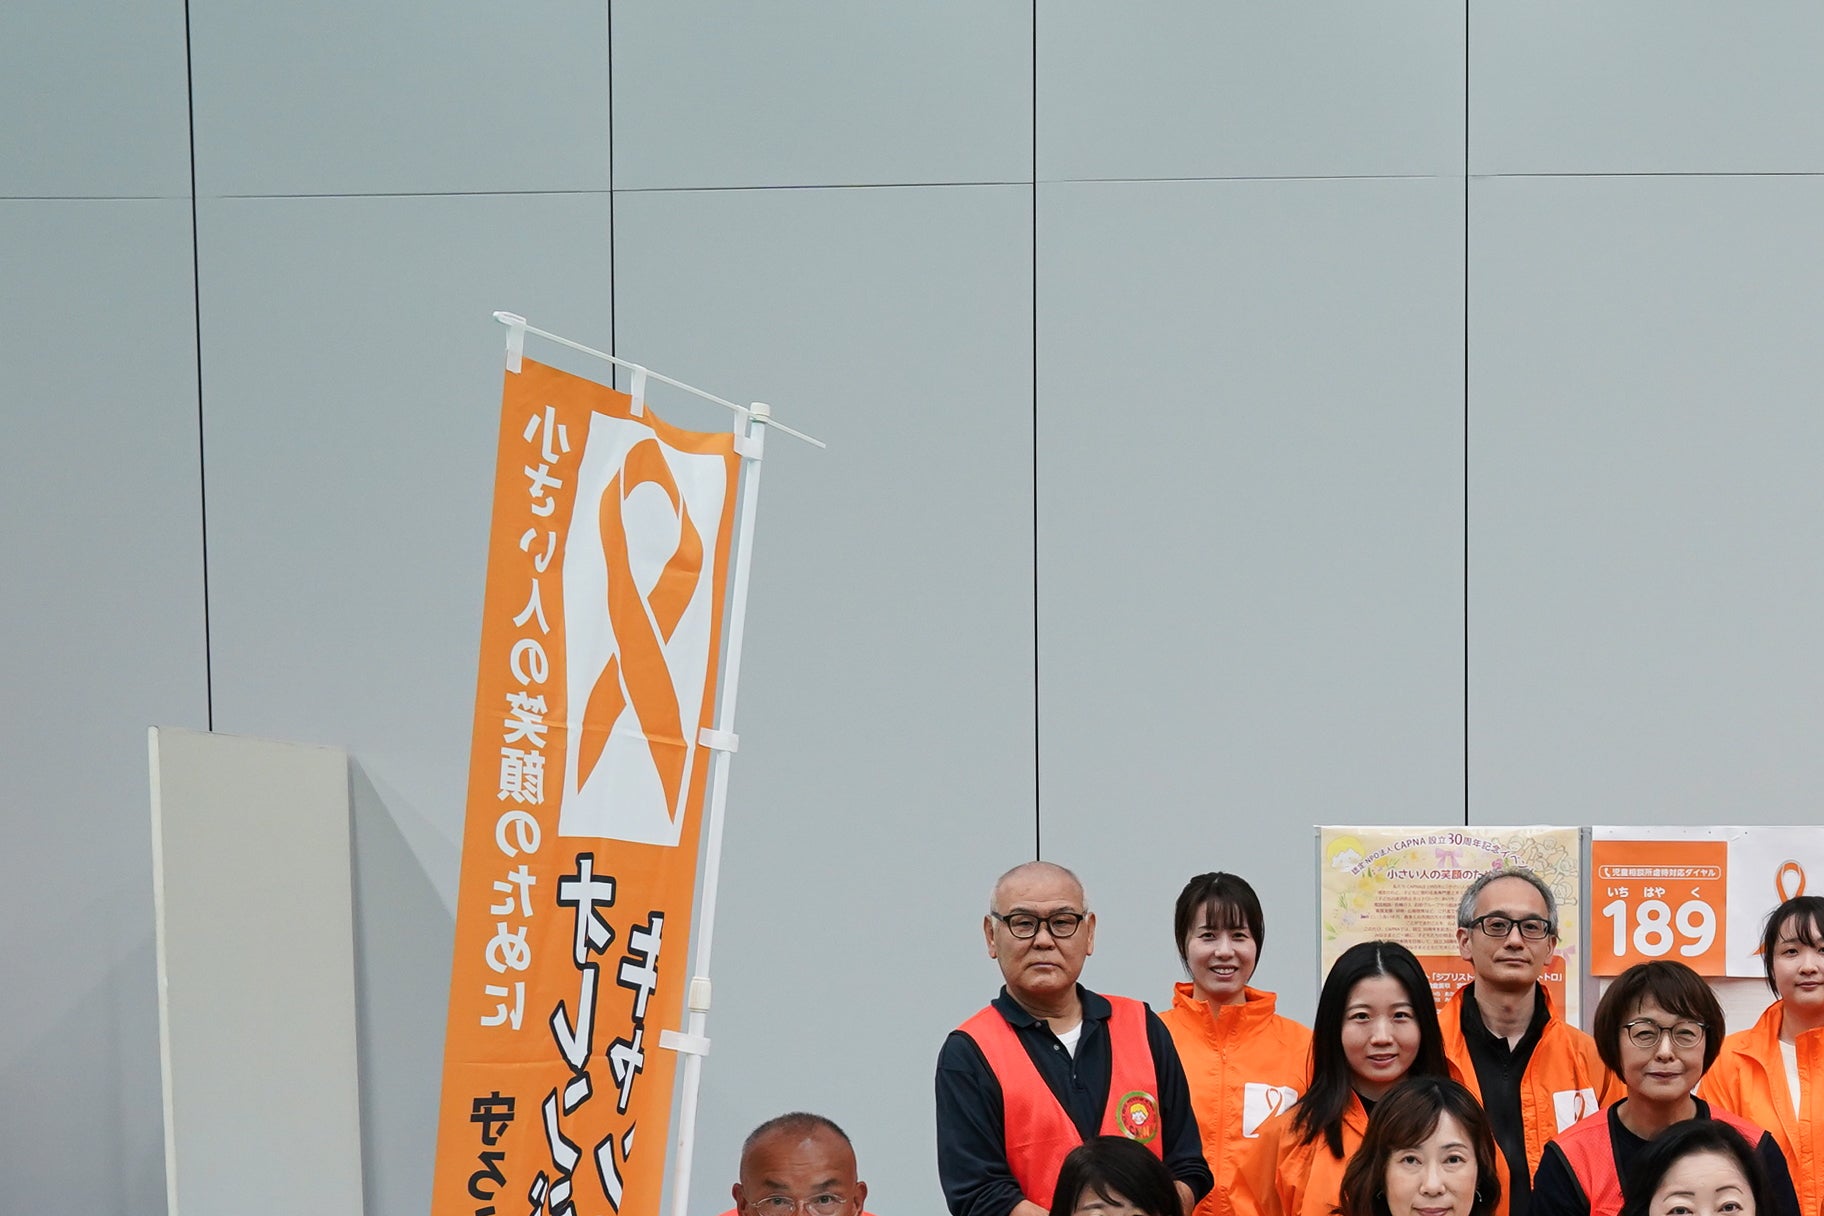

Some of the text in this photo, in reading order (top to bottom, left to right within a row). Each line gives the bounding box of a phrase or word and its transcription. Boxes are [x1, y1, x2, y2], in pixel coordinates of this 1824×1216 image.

[1394, 837, 1427, 851] CAPNA
[1607, 887, 1700, 898] いち はや く
[1602, 899, 1717, 957] 189
